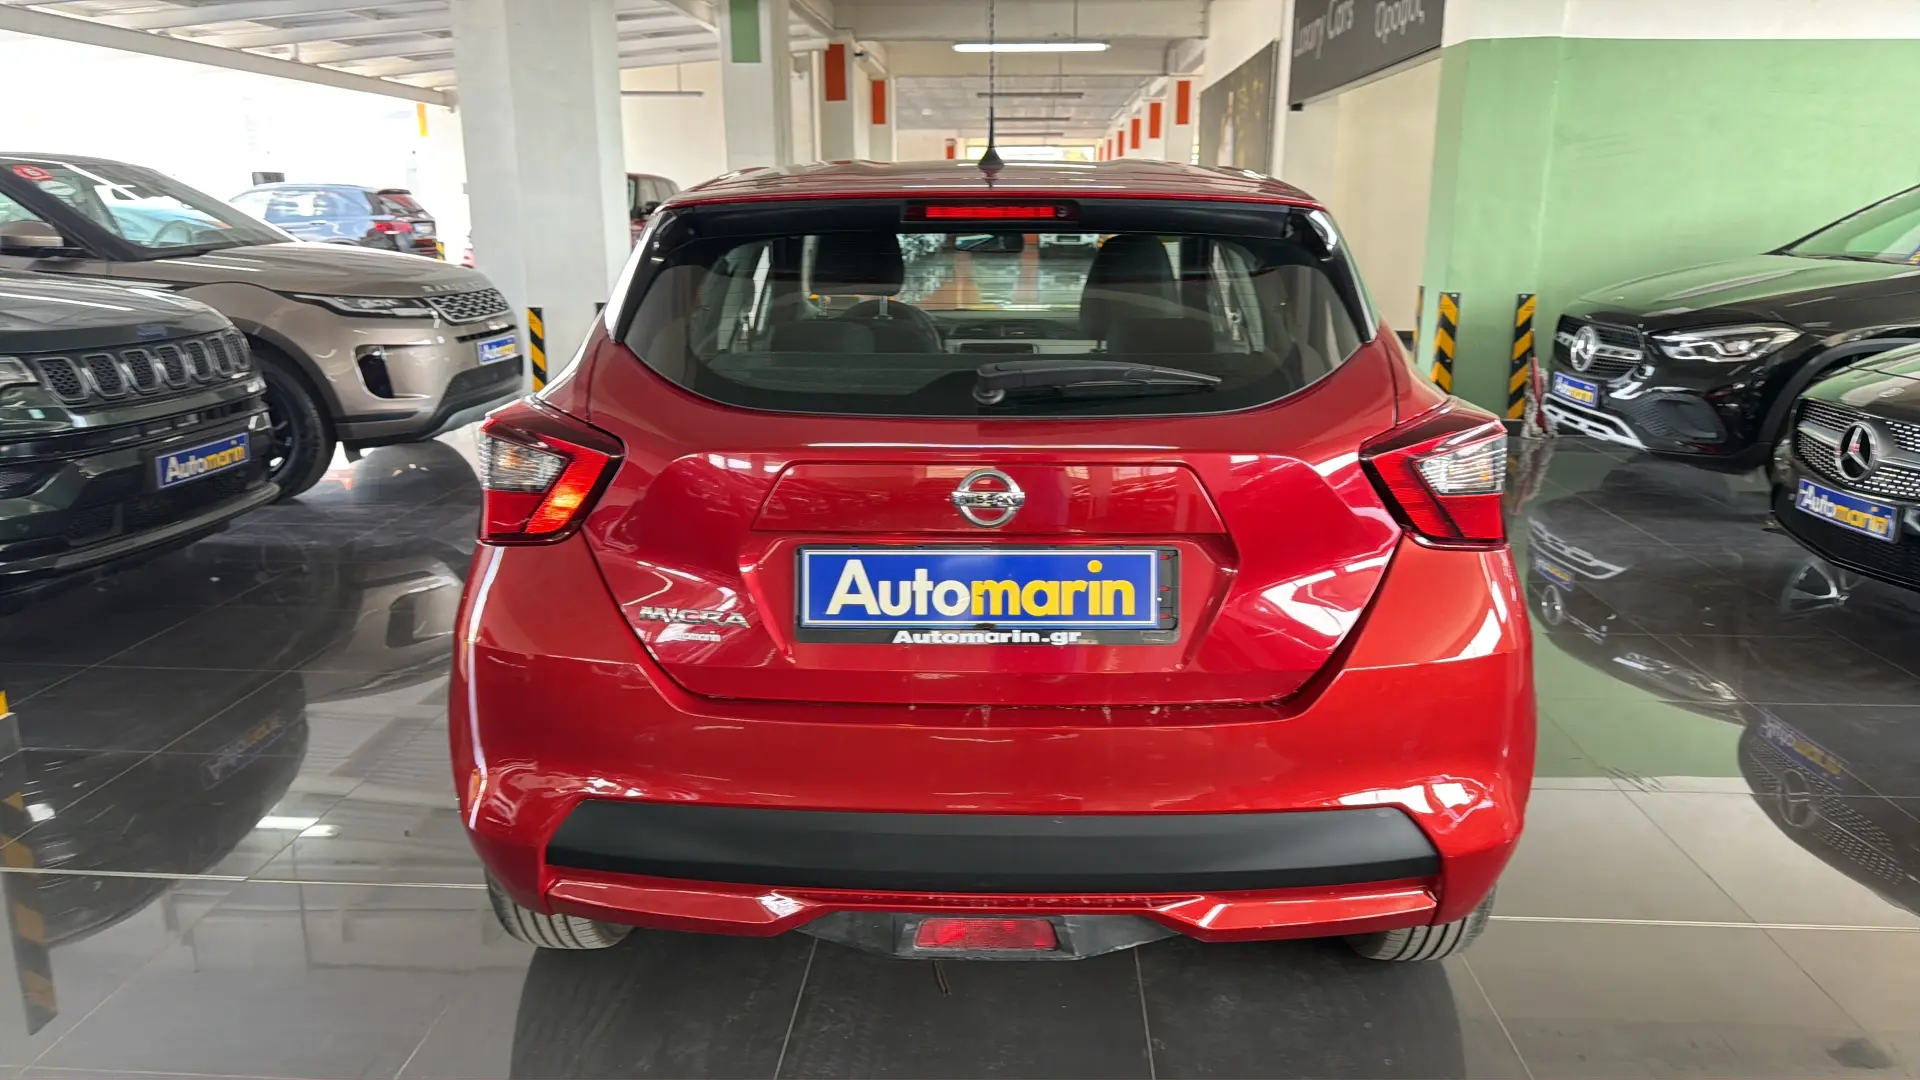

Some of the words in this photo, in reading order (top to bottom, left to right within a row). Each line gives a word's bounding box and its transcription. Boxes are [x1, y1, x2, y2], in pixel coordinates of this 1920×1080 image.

[165, 440, 245, 483] Automarin
[1800, 485, 1888, 535] Automarin
[825, 559, 1136, 617] Automarin
[640, 606, 751, 628] MICRA
[892, 630, 1082, 646] Automarin.gr
